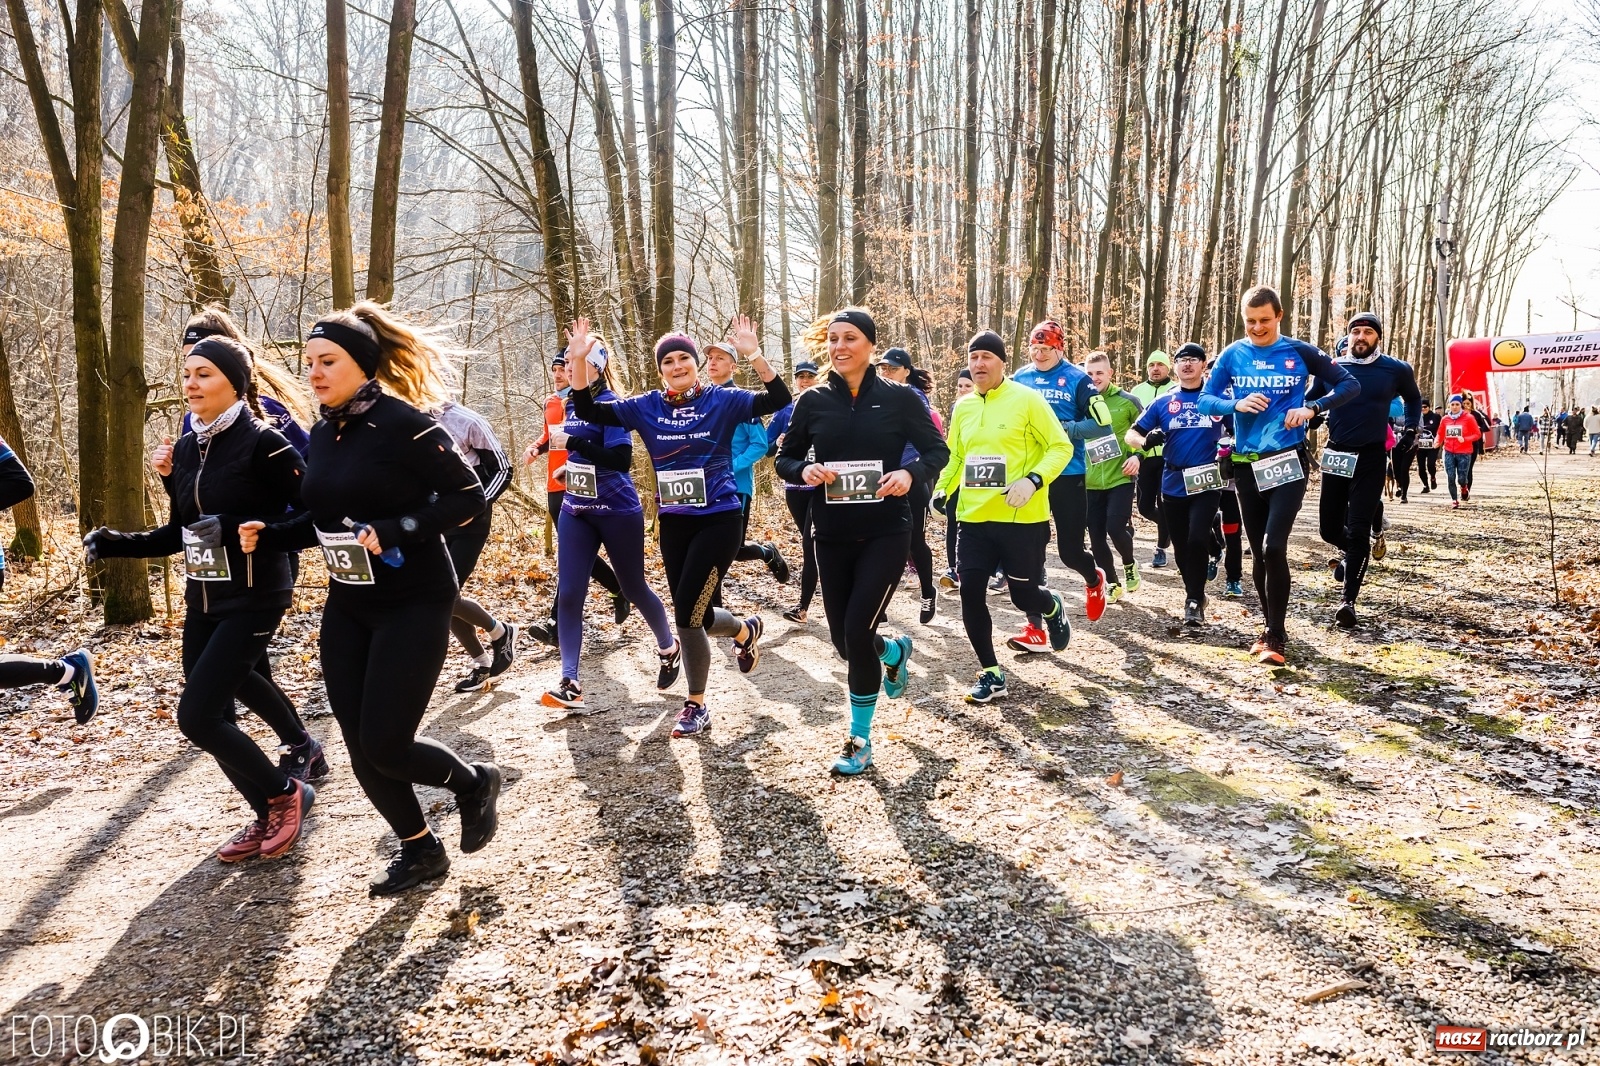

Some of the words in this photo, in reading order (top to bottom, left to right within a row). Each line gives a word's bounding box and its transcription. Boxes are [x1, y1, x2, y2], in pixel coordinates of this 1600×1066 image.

[1540, 353, 1599, 365] RACIBÓRZ
[689, 431, 710, 439] TEAM
[1094, 443, 1112, 456] 133
[1327, 455, 1348, 468] 034
[973, 465, 995, 479] 127
[1263, 462, 1293, 480] 094
[570, 473, 587, 488] 142
[840, 474, 867, 491] 112
[1193, 472, 1214, 485] 016
[667, 481, 694, 496] 100
[186, 545, 215, 565] 054
[323, 546, 352, 569] 013
